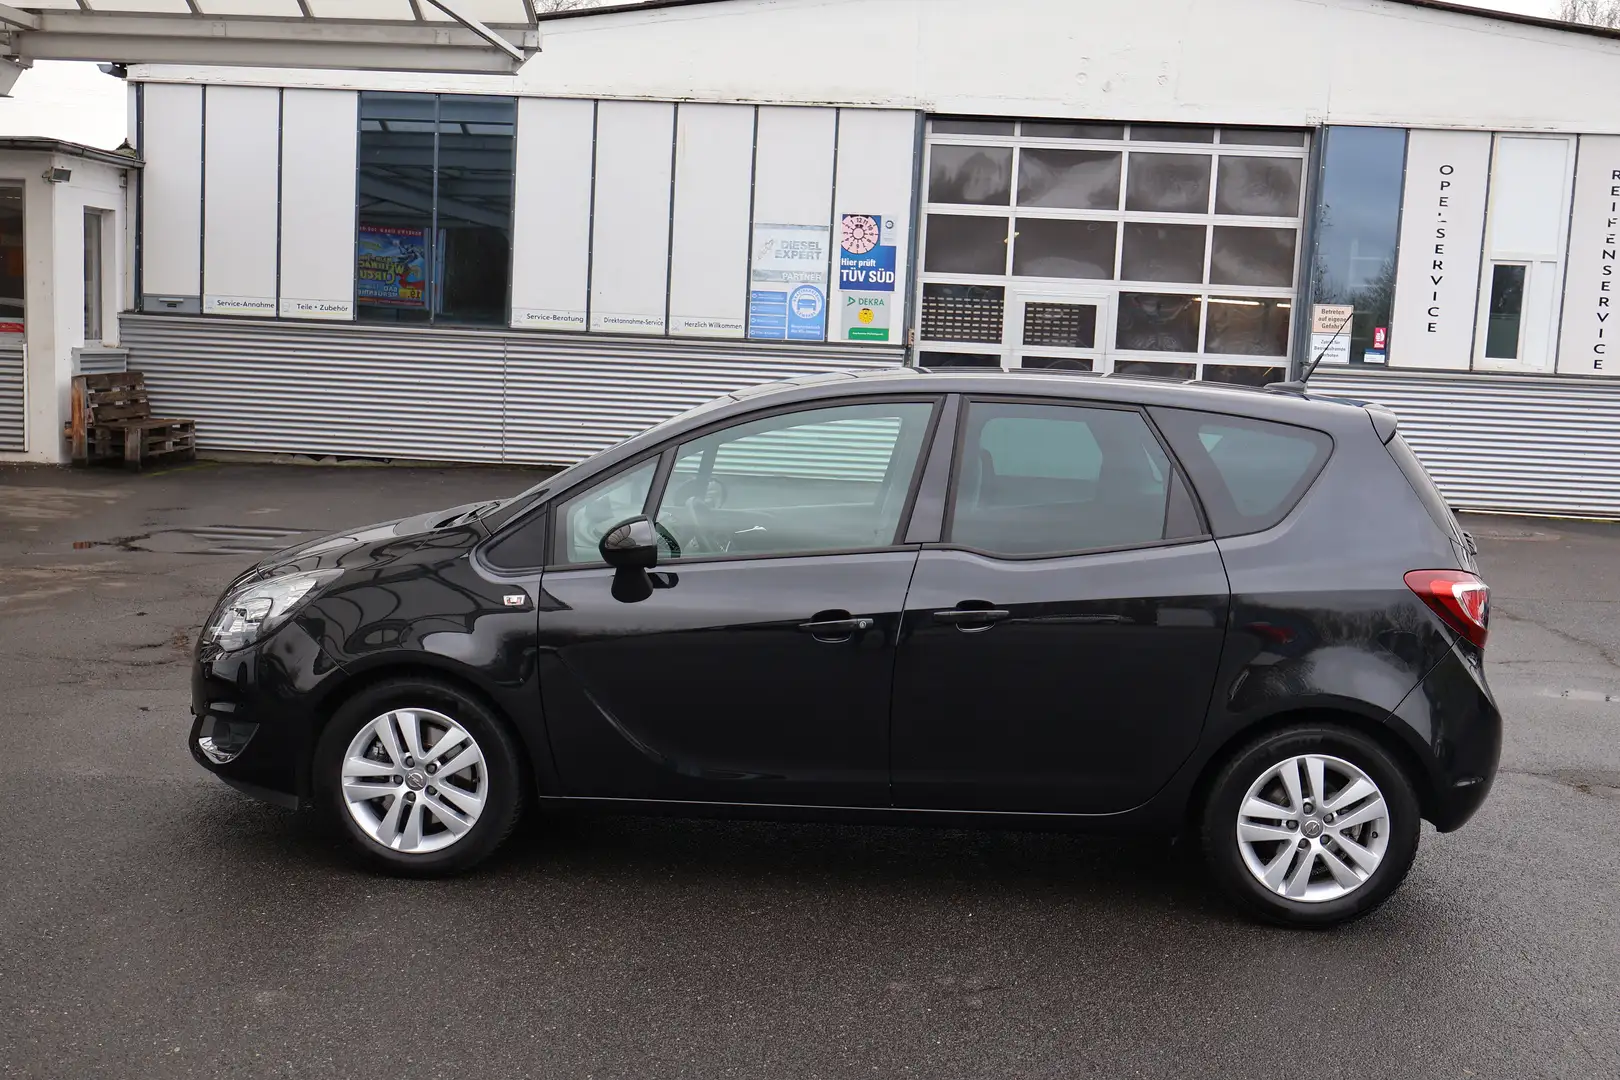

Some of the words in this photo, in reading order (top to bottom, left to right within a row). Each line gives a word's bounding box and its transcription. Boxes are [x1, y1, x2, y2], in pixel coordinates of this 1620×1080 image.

[780, 240, 822, 250] DIESEL
[775, 250, 822, 260] EXPERT
[841, 258, 857, 266] Hier
[858, 258, 876, 268] prüft
[841, 267, 866, 282] TÜV
[868, 268, 894, 283] SÜD
[1594, 170, 1620, 370] REIFENSERVICE
[782, 272, 822, 281] PARTNER
[216, 300, 275, 309] Service-Annahme
[858, 297, 884, 306] DEKRA
[526, 313, 584, 323] Service-Beratung
[604, 317, 664, 326] Direktannahme-Service
